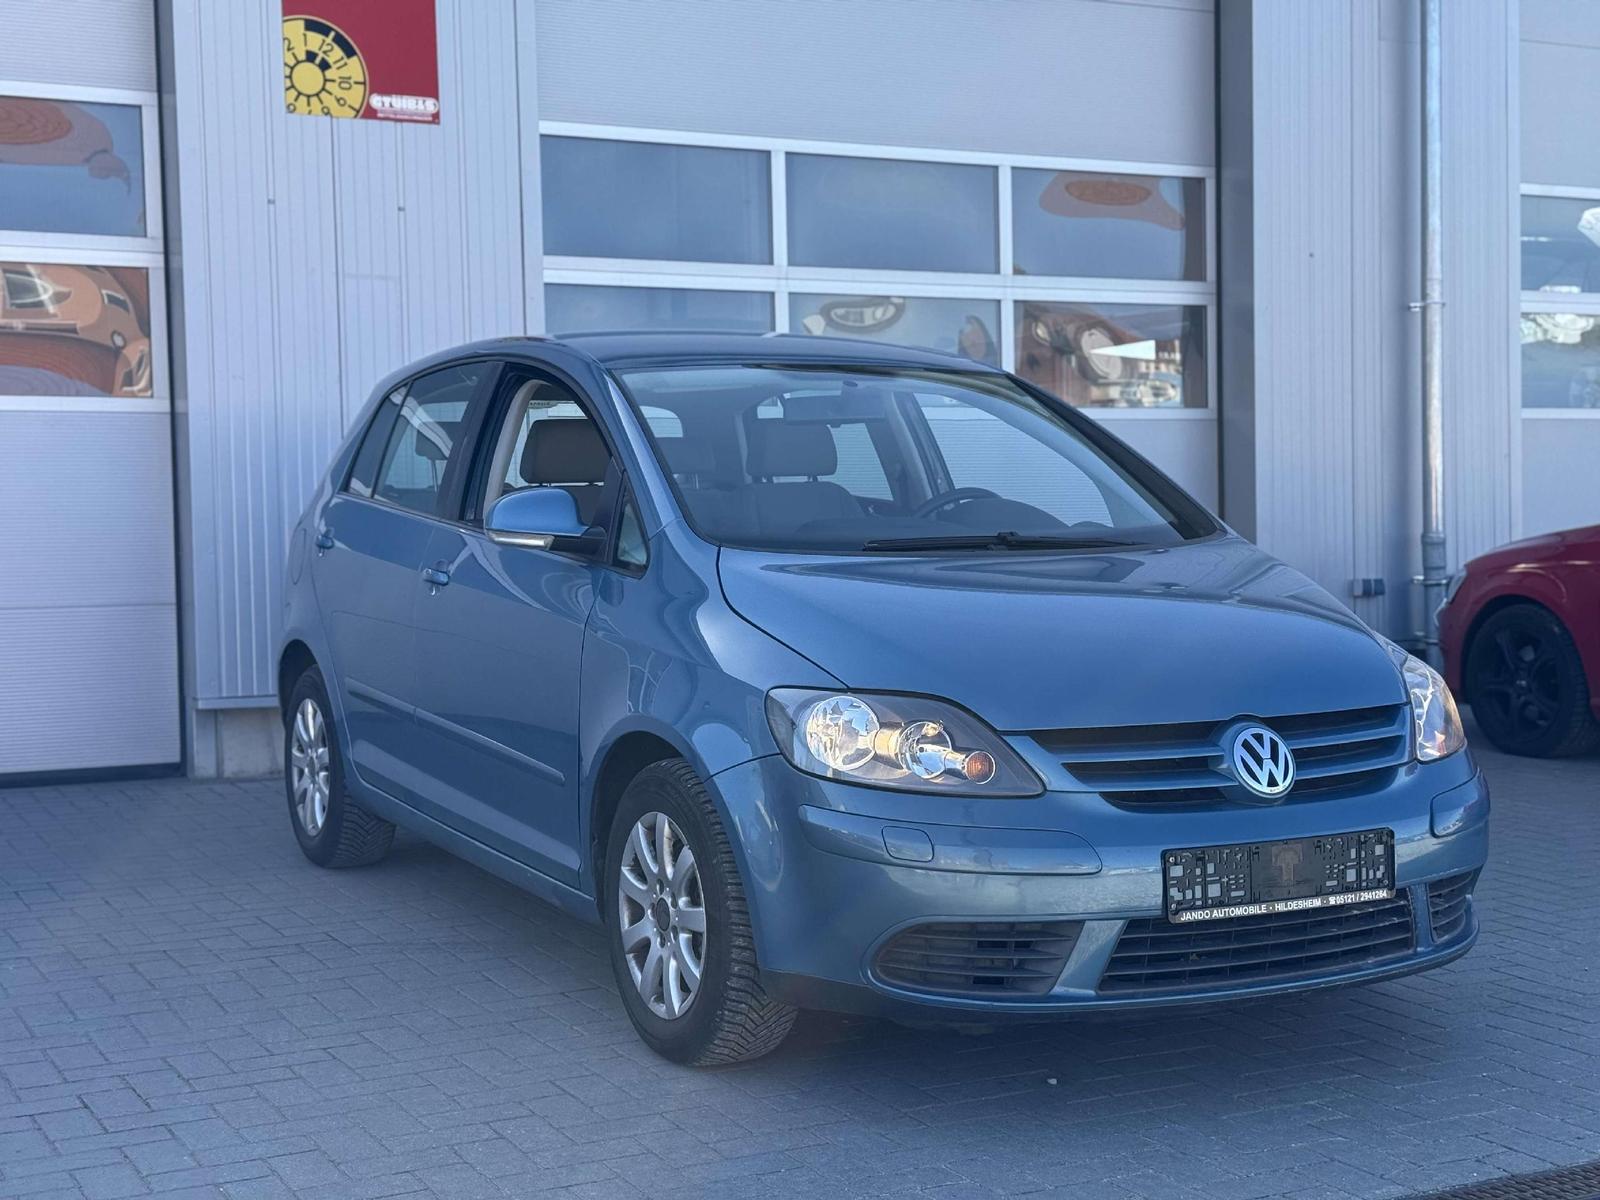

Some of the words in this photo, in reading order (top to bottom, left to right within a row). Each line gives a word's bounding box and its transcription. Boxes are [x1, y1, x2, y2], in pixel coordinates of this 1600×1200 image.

[318, 39, 334, 57] 12
[333, 56, 348, 70] 11
[338, 76, 352, 90] 10
[1234, 728, 1293, 792] VW
[1180, 910, 1211, 921] JANDO
[1212, 904, 1267, 918] AUTOMOBILE
[1275, 898, 1322, 911] HILDESHEIM
